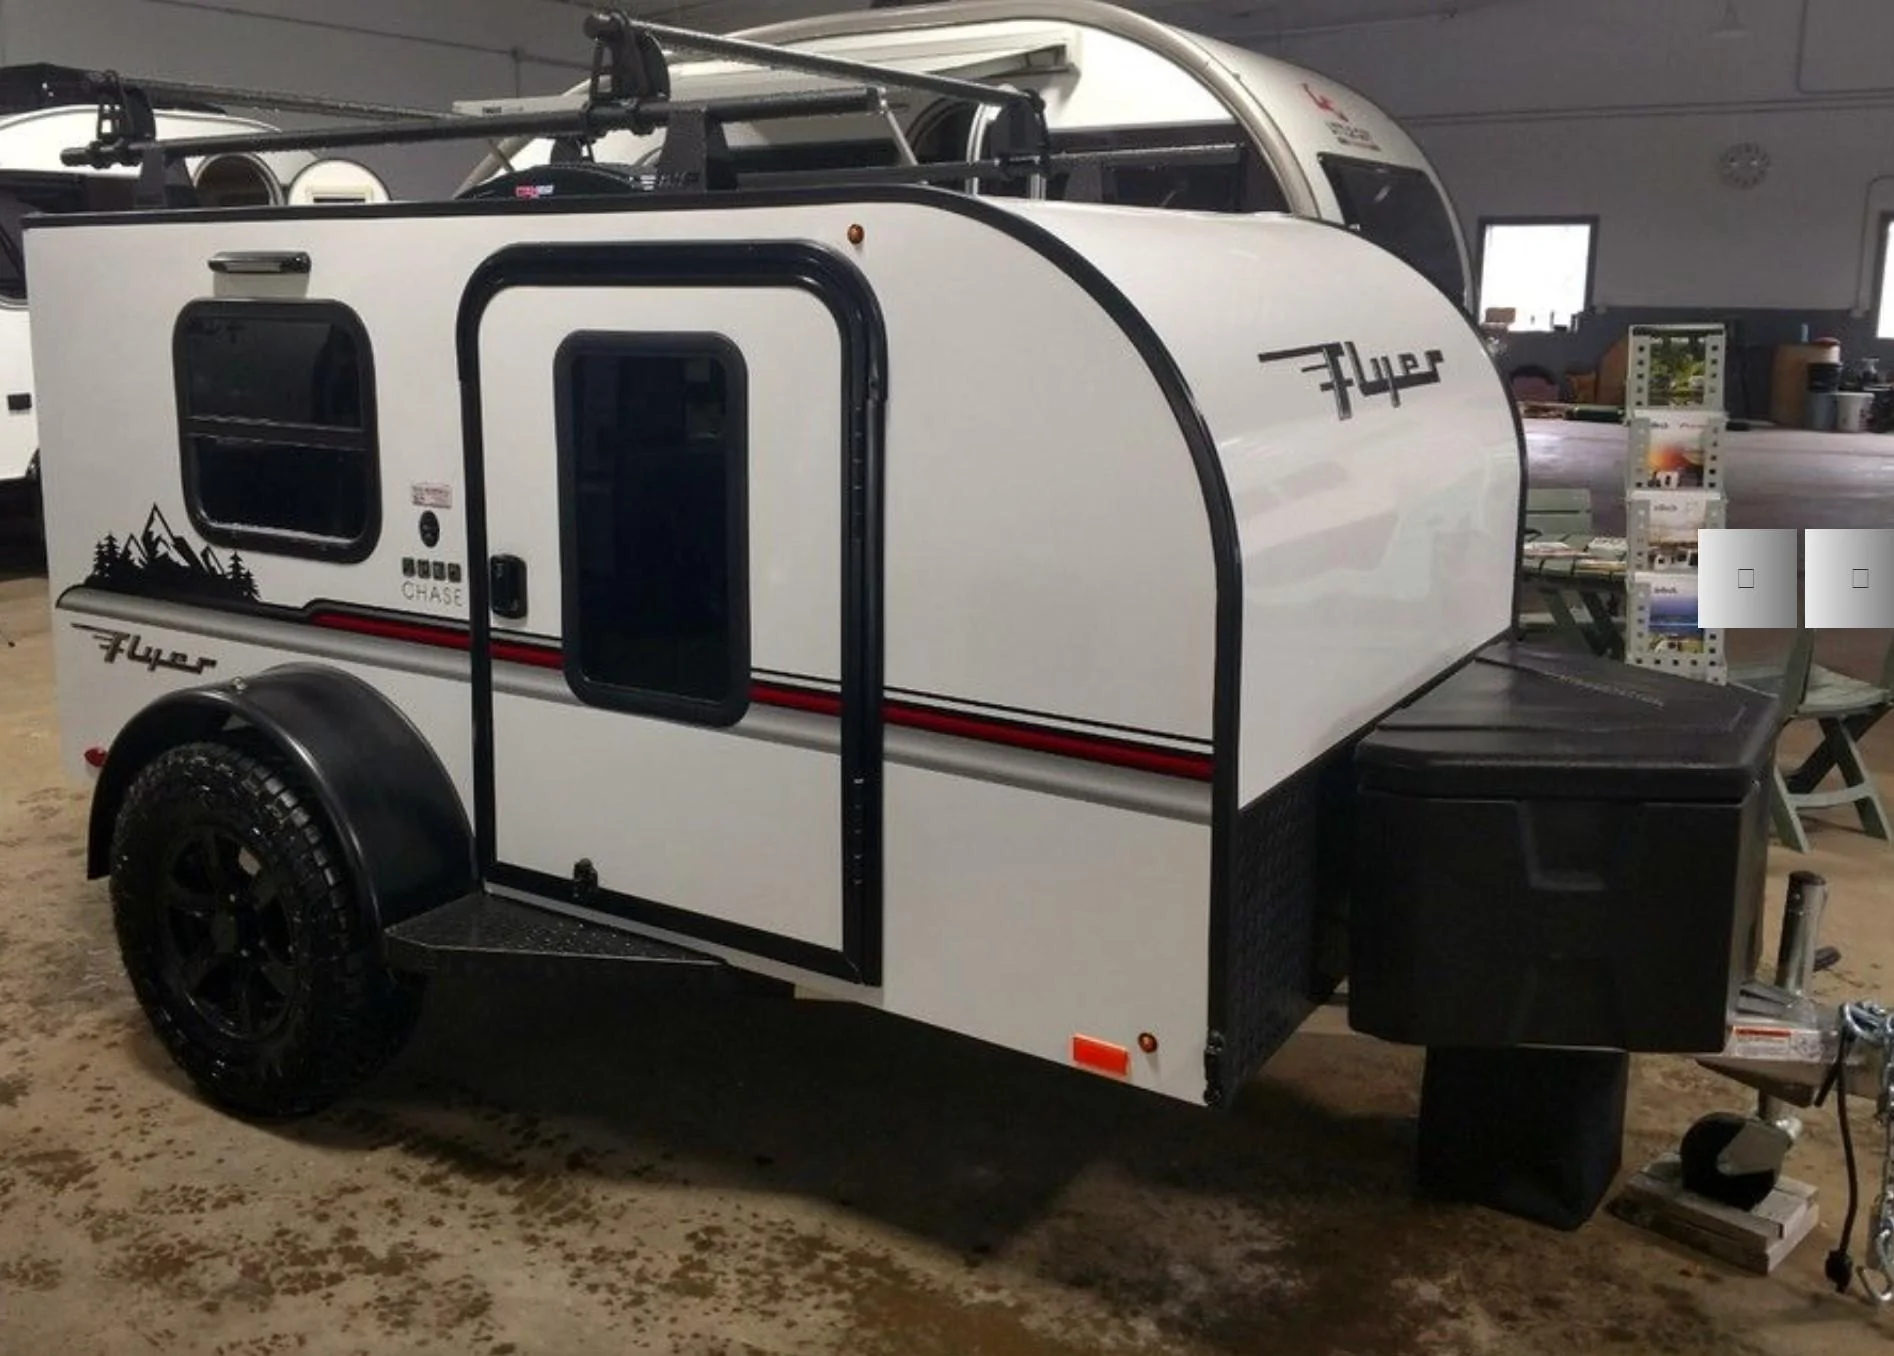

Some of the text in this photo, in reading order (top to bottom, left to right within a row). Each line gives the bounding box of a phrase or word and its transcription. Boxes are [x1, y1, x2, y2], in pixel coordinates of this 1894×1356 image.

[1257, 341, 1444, 421] Flyer
[401, 580, 462, 608] CHASE
[70, 623, 217, 674] Flyer
